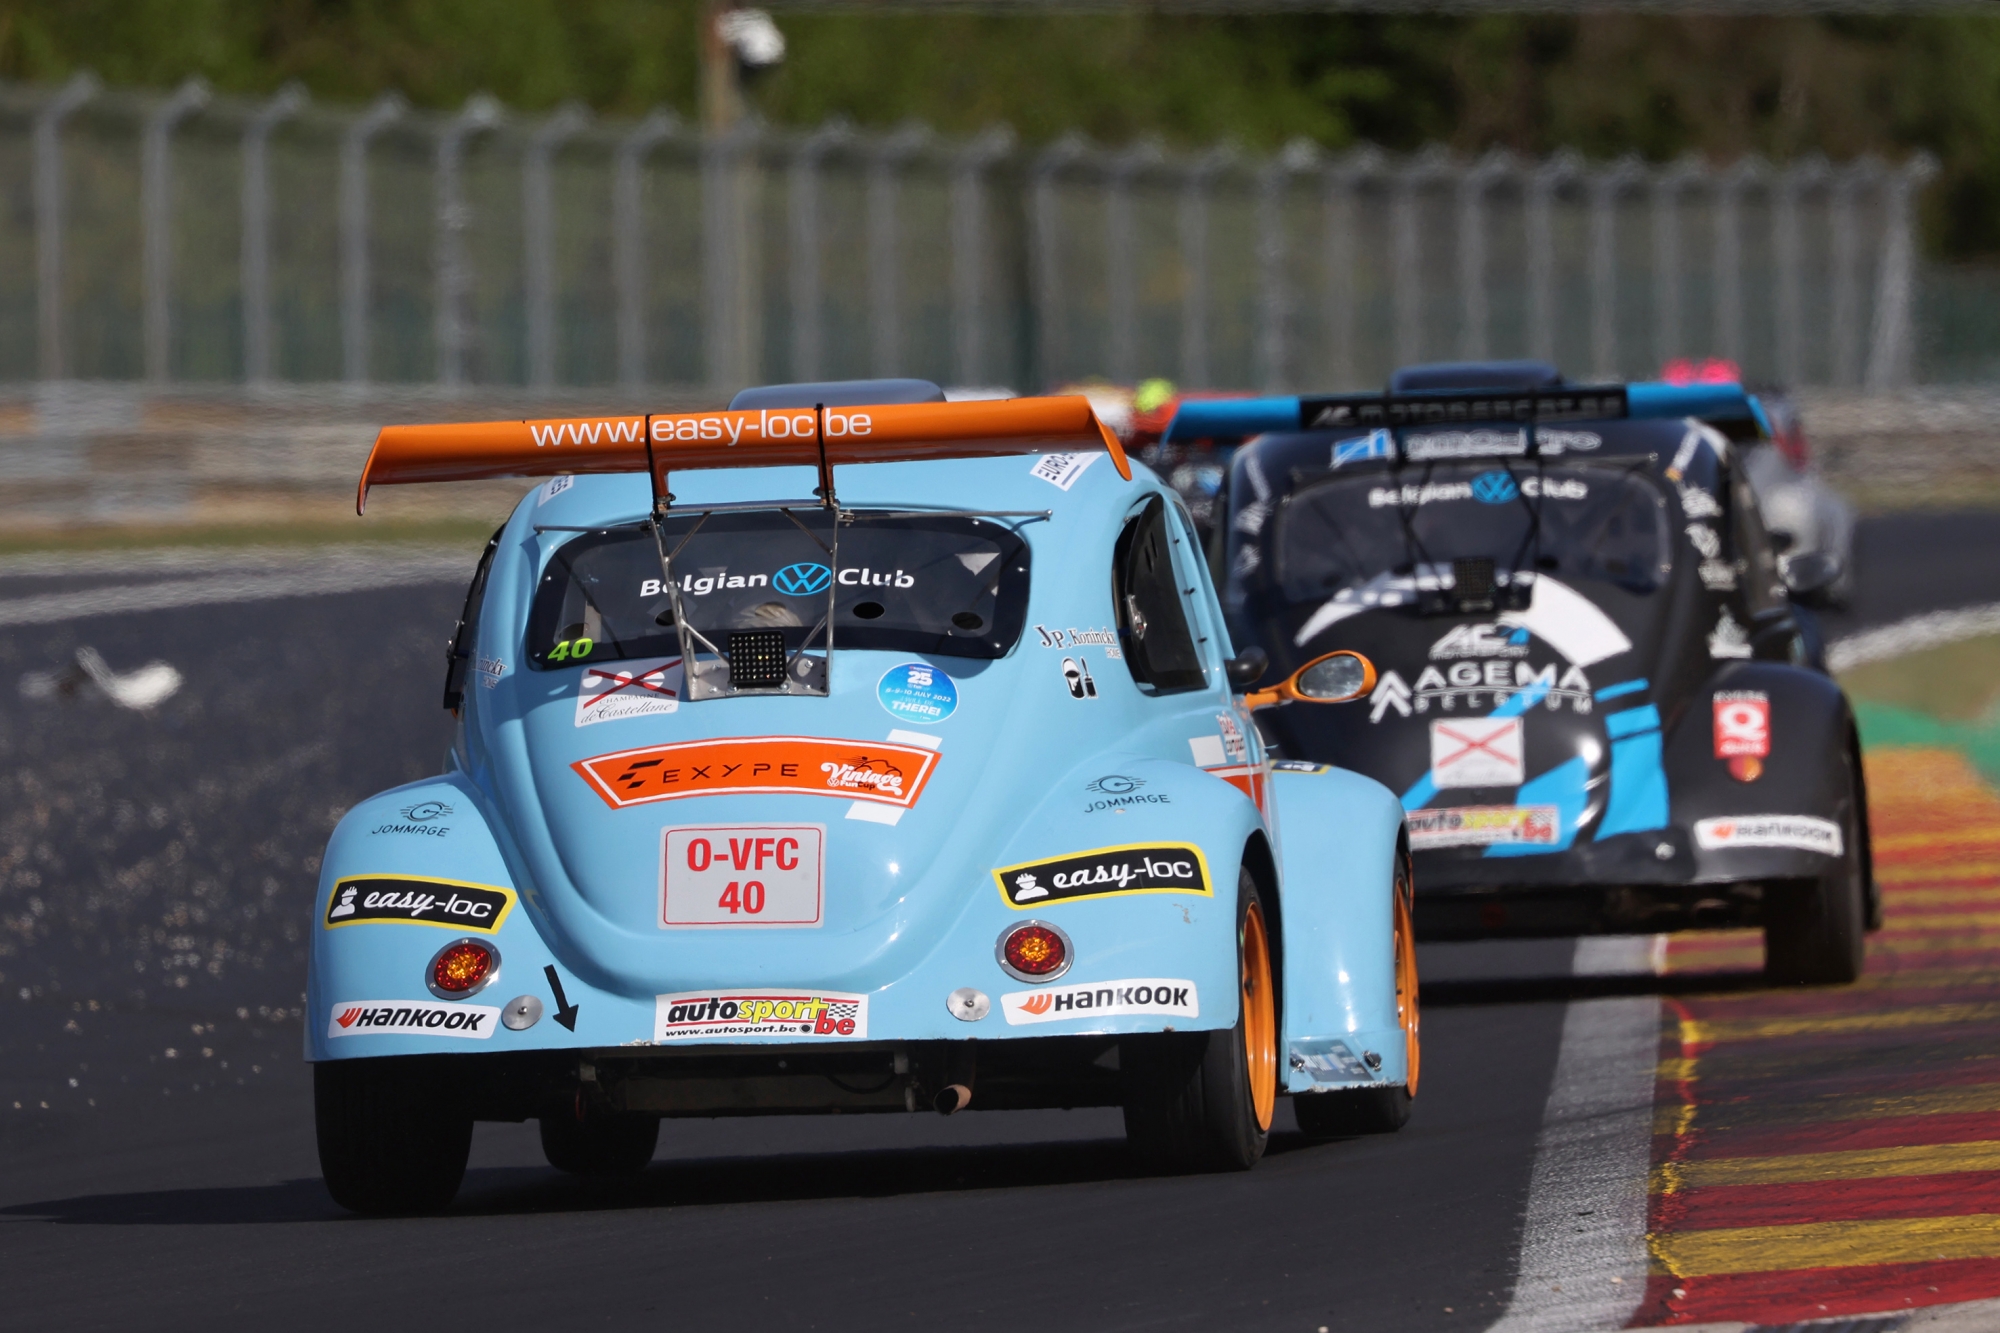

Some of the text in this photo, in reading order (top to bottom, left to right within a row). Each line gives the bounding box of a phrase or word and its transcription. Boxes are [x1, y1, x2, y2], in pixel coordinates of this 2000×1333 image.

[530, 408, 872, 447] www.easy-locbe
[1520, 476, 1588, 500] Club
[838, 567, 915, 588] Club
[547, 637, 593, 661] 40
[907, 670, 933, 687] 25
[1414, 660, 1591, 692] AGEMA
[599, 692, 660, 705] CHAMPAGNE
[913, 691, 932, 699] JULY
[932, 694, 952, 703] 2022
[892, 700, 942, 716] THERE!
[662, 763, 800, 784] EXYPE
[820, 761, 903, 796] Vintage
[1084, 793, 1171, 814] JOMMAGE
[371, 824, 450, 838] JOMMAGE
[1052, 856, 1193, 888] easy-loc
[363, 890, 492, 919] easy-loc
[717, 880, 765, 914] 40
[665, 1024, 797, 1037] www.autosport.be
